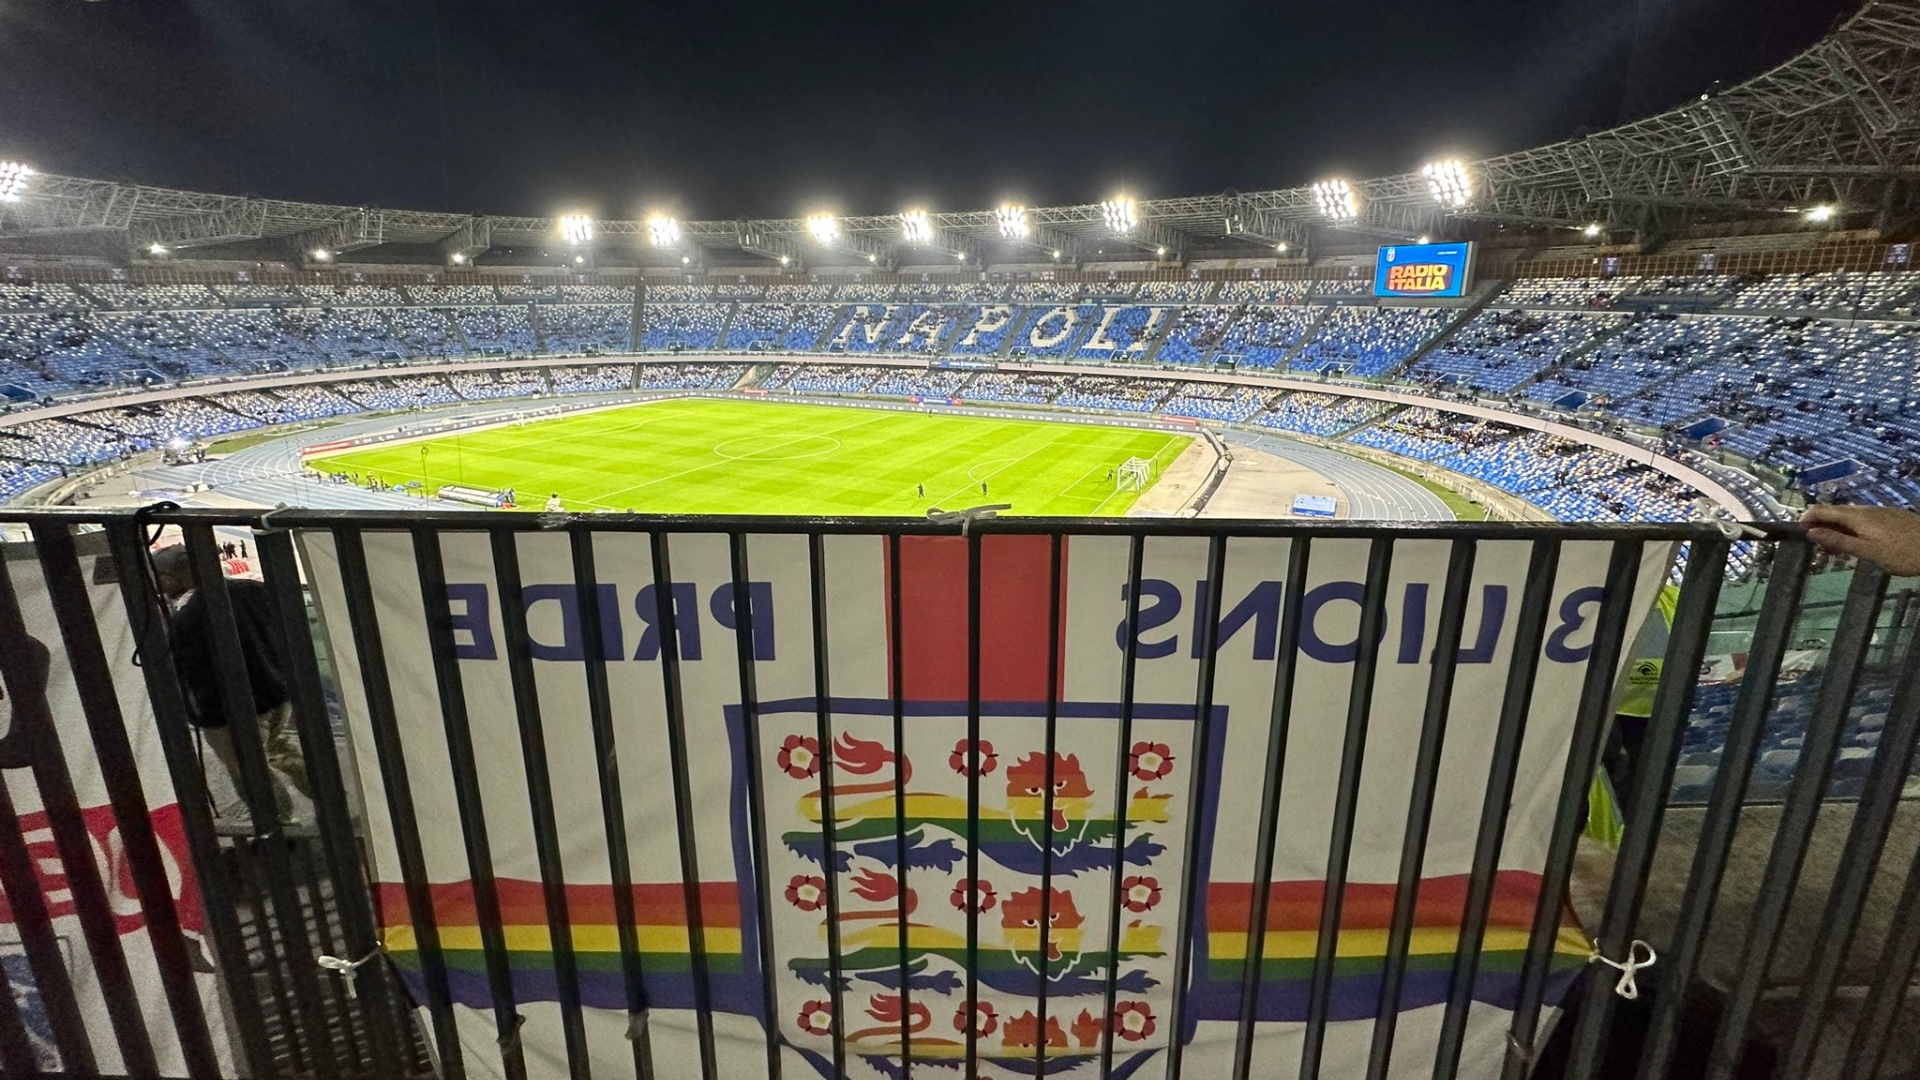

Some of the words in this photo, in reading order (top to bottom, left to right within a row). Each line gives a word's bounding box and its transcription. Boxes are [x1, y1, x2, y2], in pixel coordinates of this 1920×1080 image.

[1390, 265, 1448, 278] RADIO
[1388, 277, 1446, 290] ITALIA
[832, 305, 1162, 350] NAPOLI
